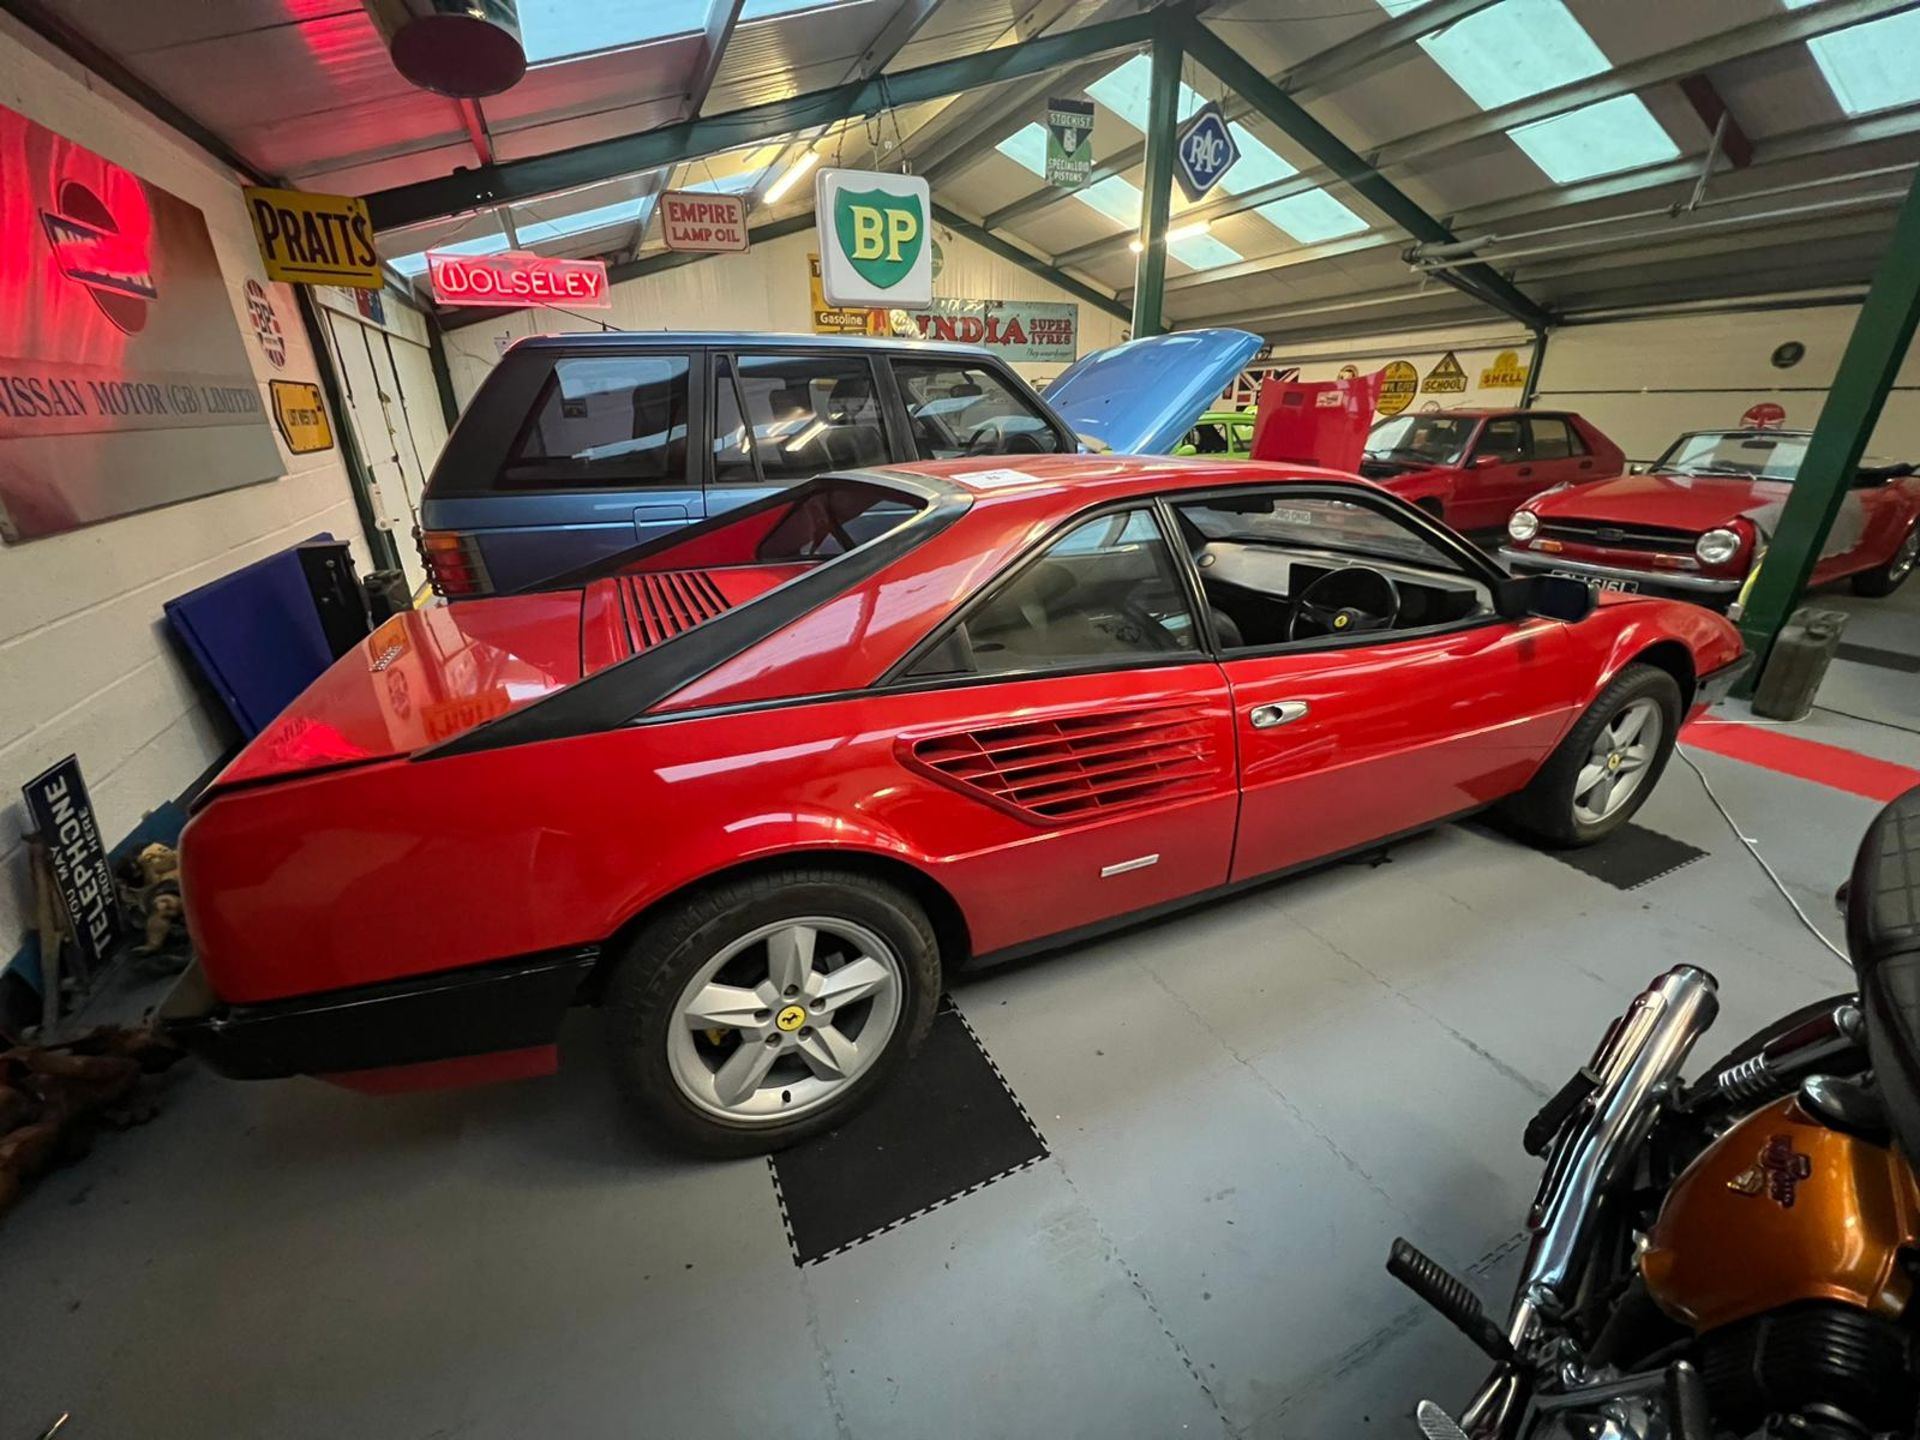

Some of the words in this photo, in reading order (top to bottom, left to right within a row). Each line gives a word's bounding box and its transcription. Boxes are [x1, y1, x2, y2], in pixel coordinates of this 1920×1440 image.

[1190, 129, 1226, 173] RAC
[668, 202, 738, 224] EMPIRE
[671, 227, 713, 242] LAMP
[714, 228, 741, 243] OIL
[848, 204, 918, 262] BP
[437, 262, 602, 297] WOLSELEY
[820, 312, 864, 326] Gasoline
[915, 315, 1028, 345] INDIA
[1030, 319, 1073, 332] SUPER
[1030, 332, 1072, 345] TYRES
[1424, 378, 1461, 391] SCHOOL
[1483, 372, 1523, 384] SHELL
[90, 381, 169, 415] MOTOR
[168, 385, 201, 416] (GB)
[204, 387, 259, 415] LIMITED
[78, 807, 99, 853] HERE
[44, 775, 111, 959] TELEPHONE
[50, 846, 70, 881] MAY
[94, 859, 114, 904] FROM
[67, 890, 82, 925] YOU
